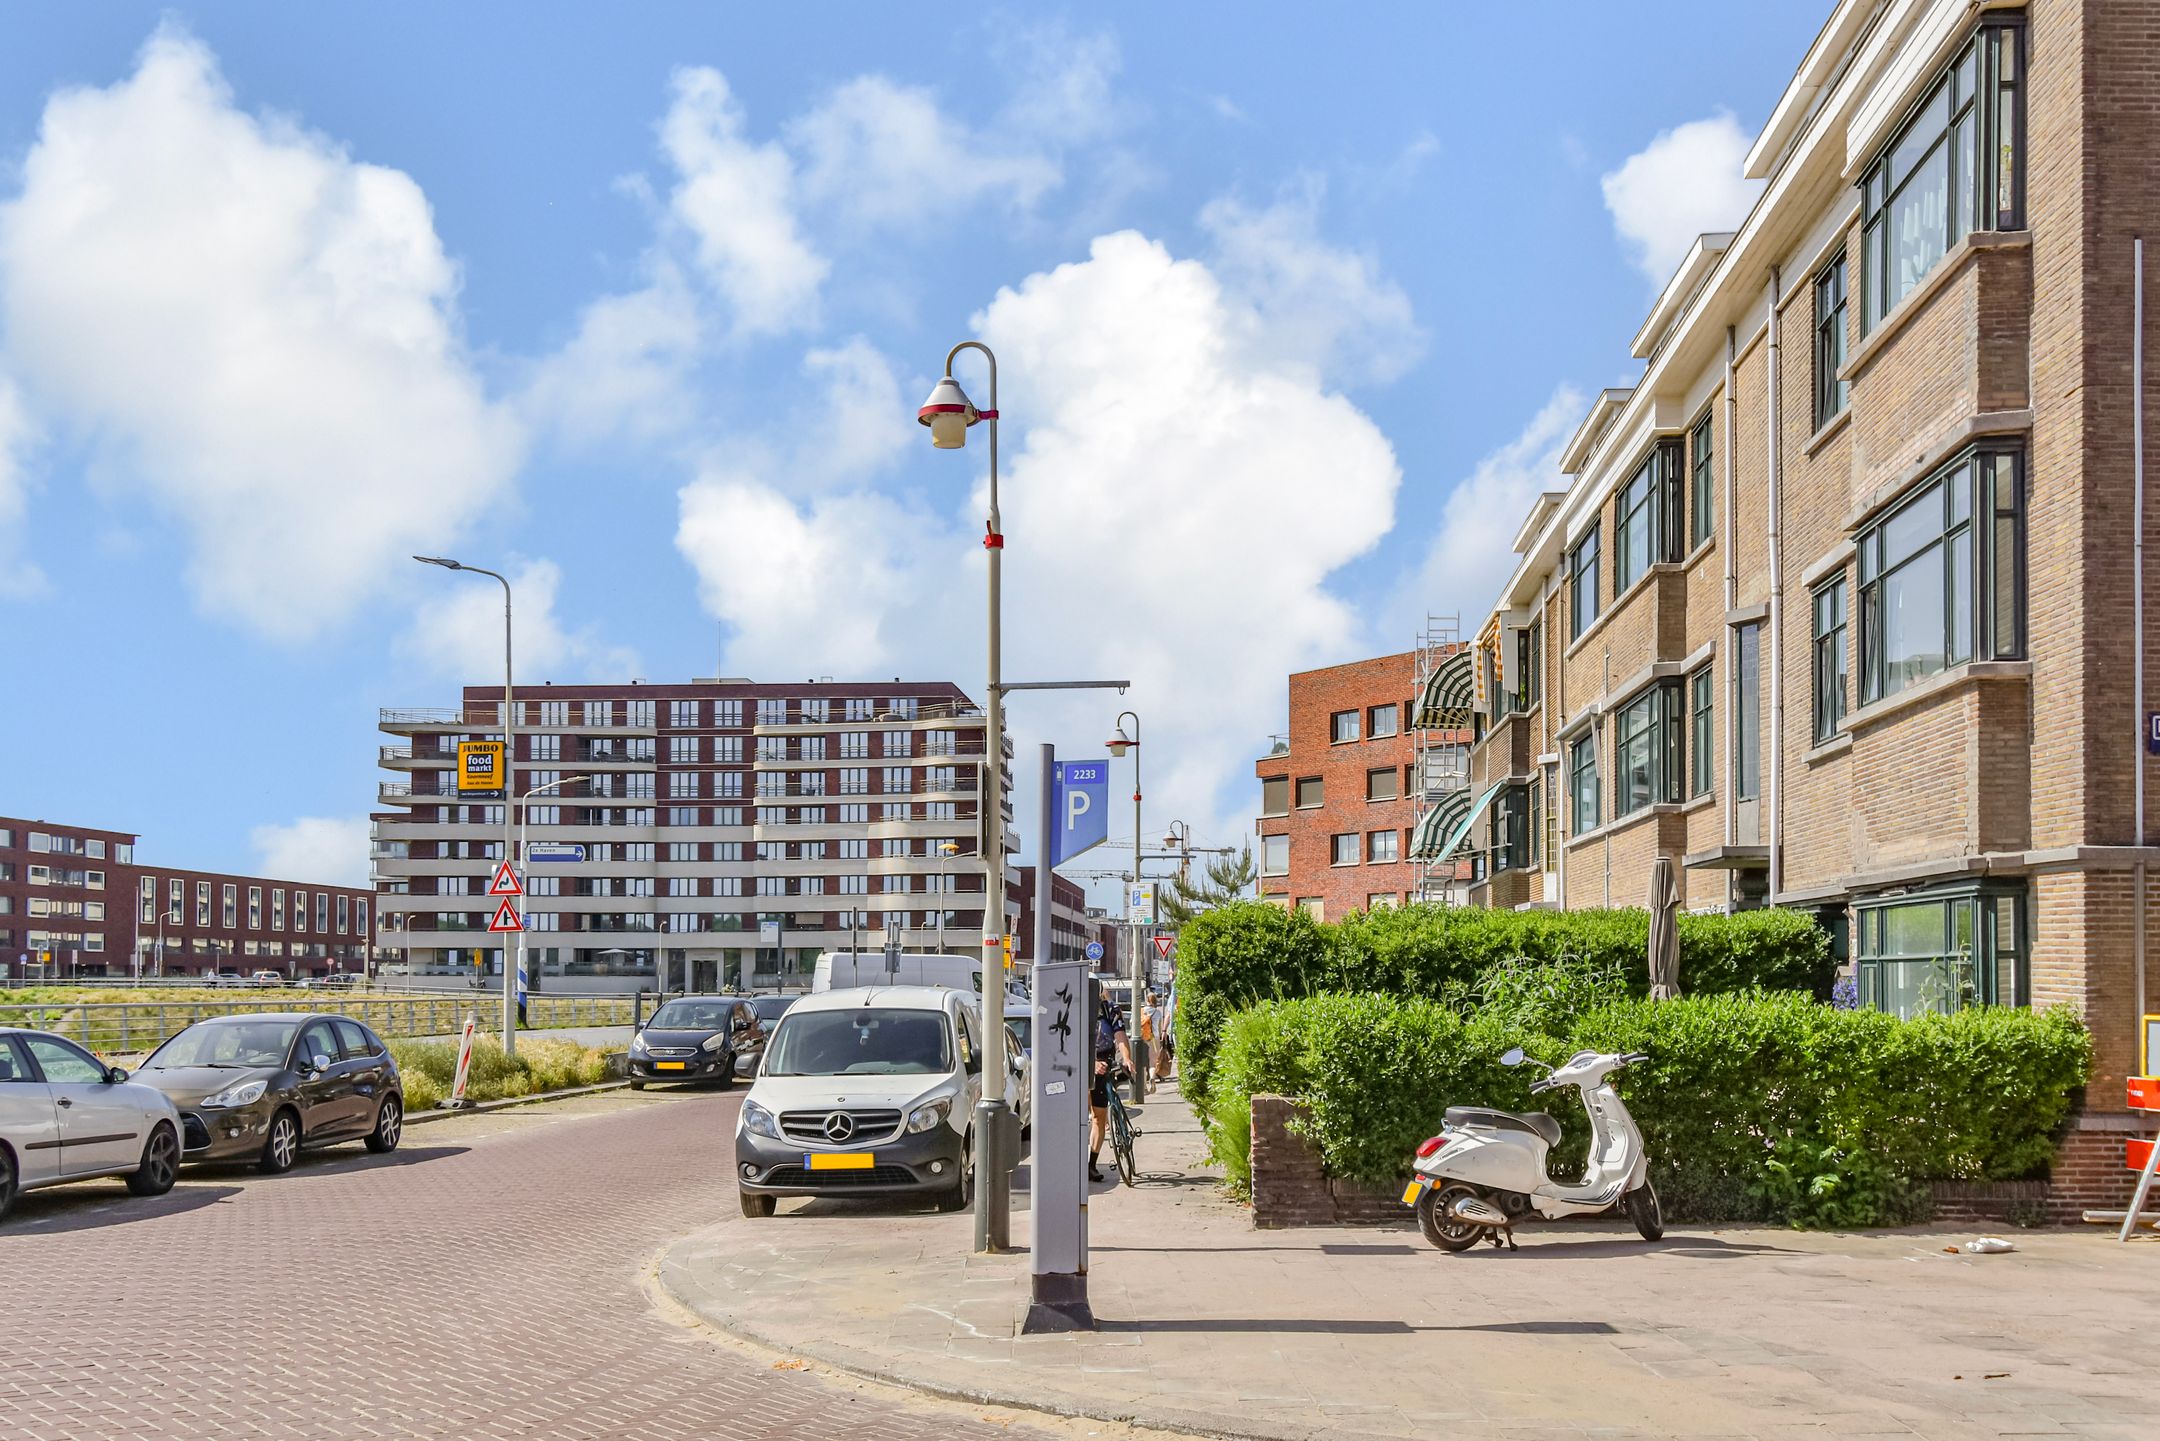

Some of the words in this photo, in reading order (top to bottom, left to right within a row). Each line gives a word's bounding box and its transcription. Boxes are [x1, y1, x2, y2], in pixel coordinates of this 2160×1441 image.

[468, 755, 492, 765] food
[1074, 769, 1096, 780] 2233
[1068, 790, 1091, 830] P
